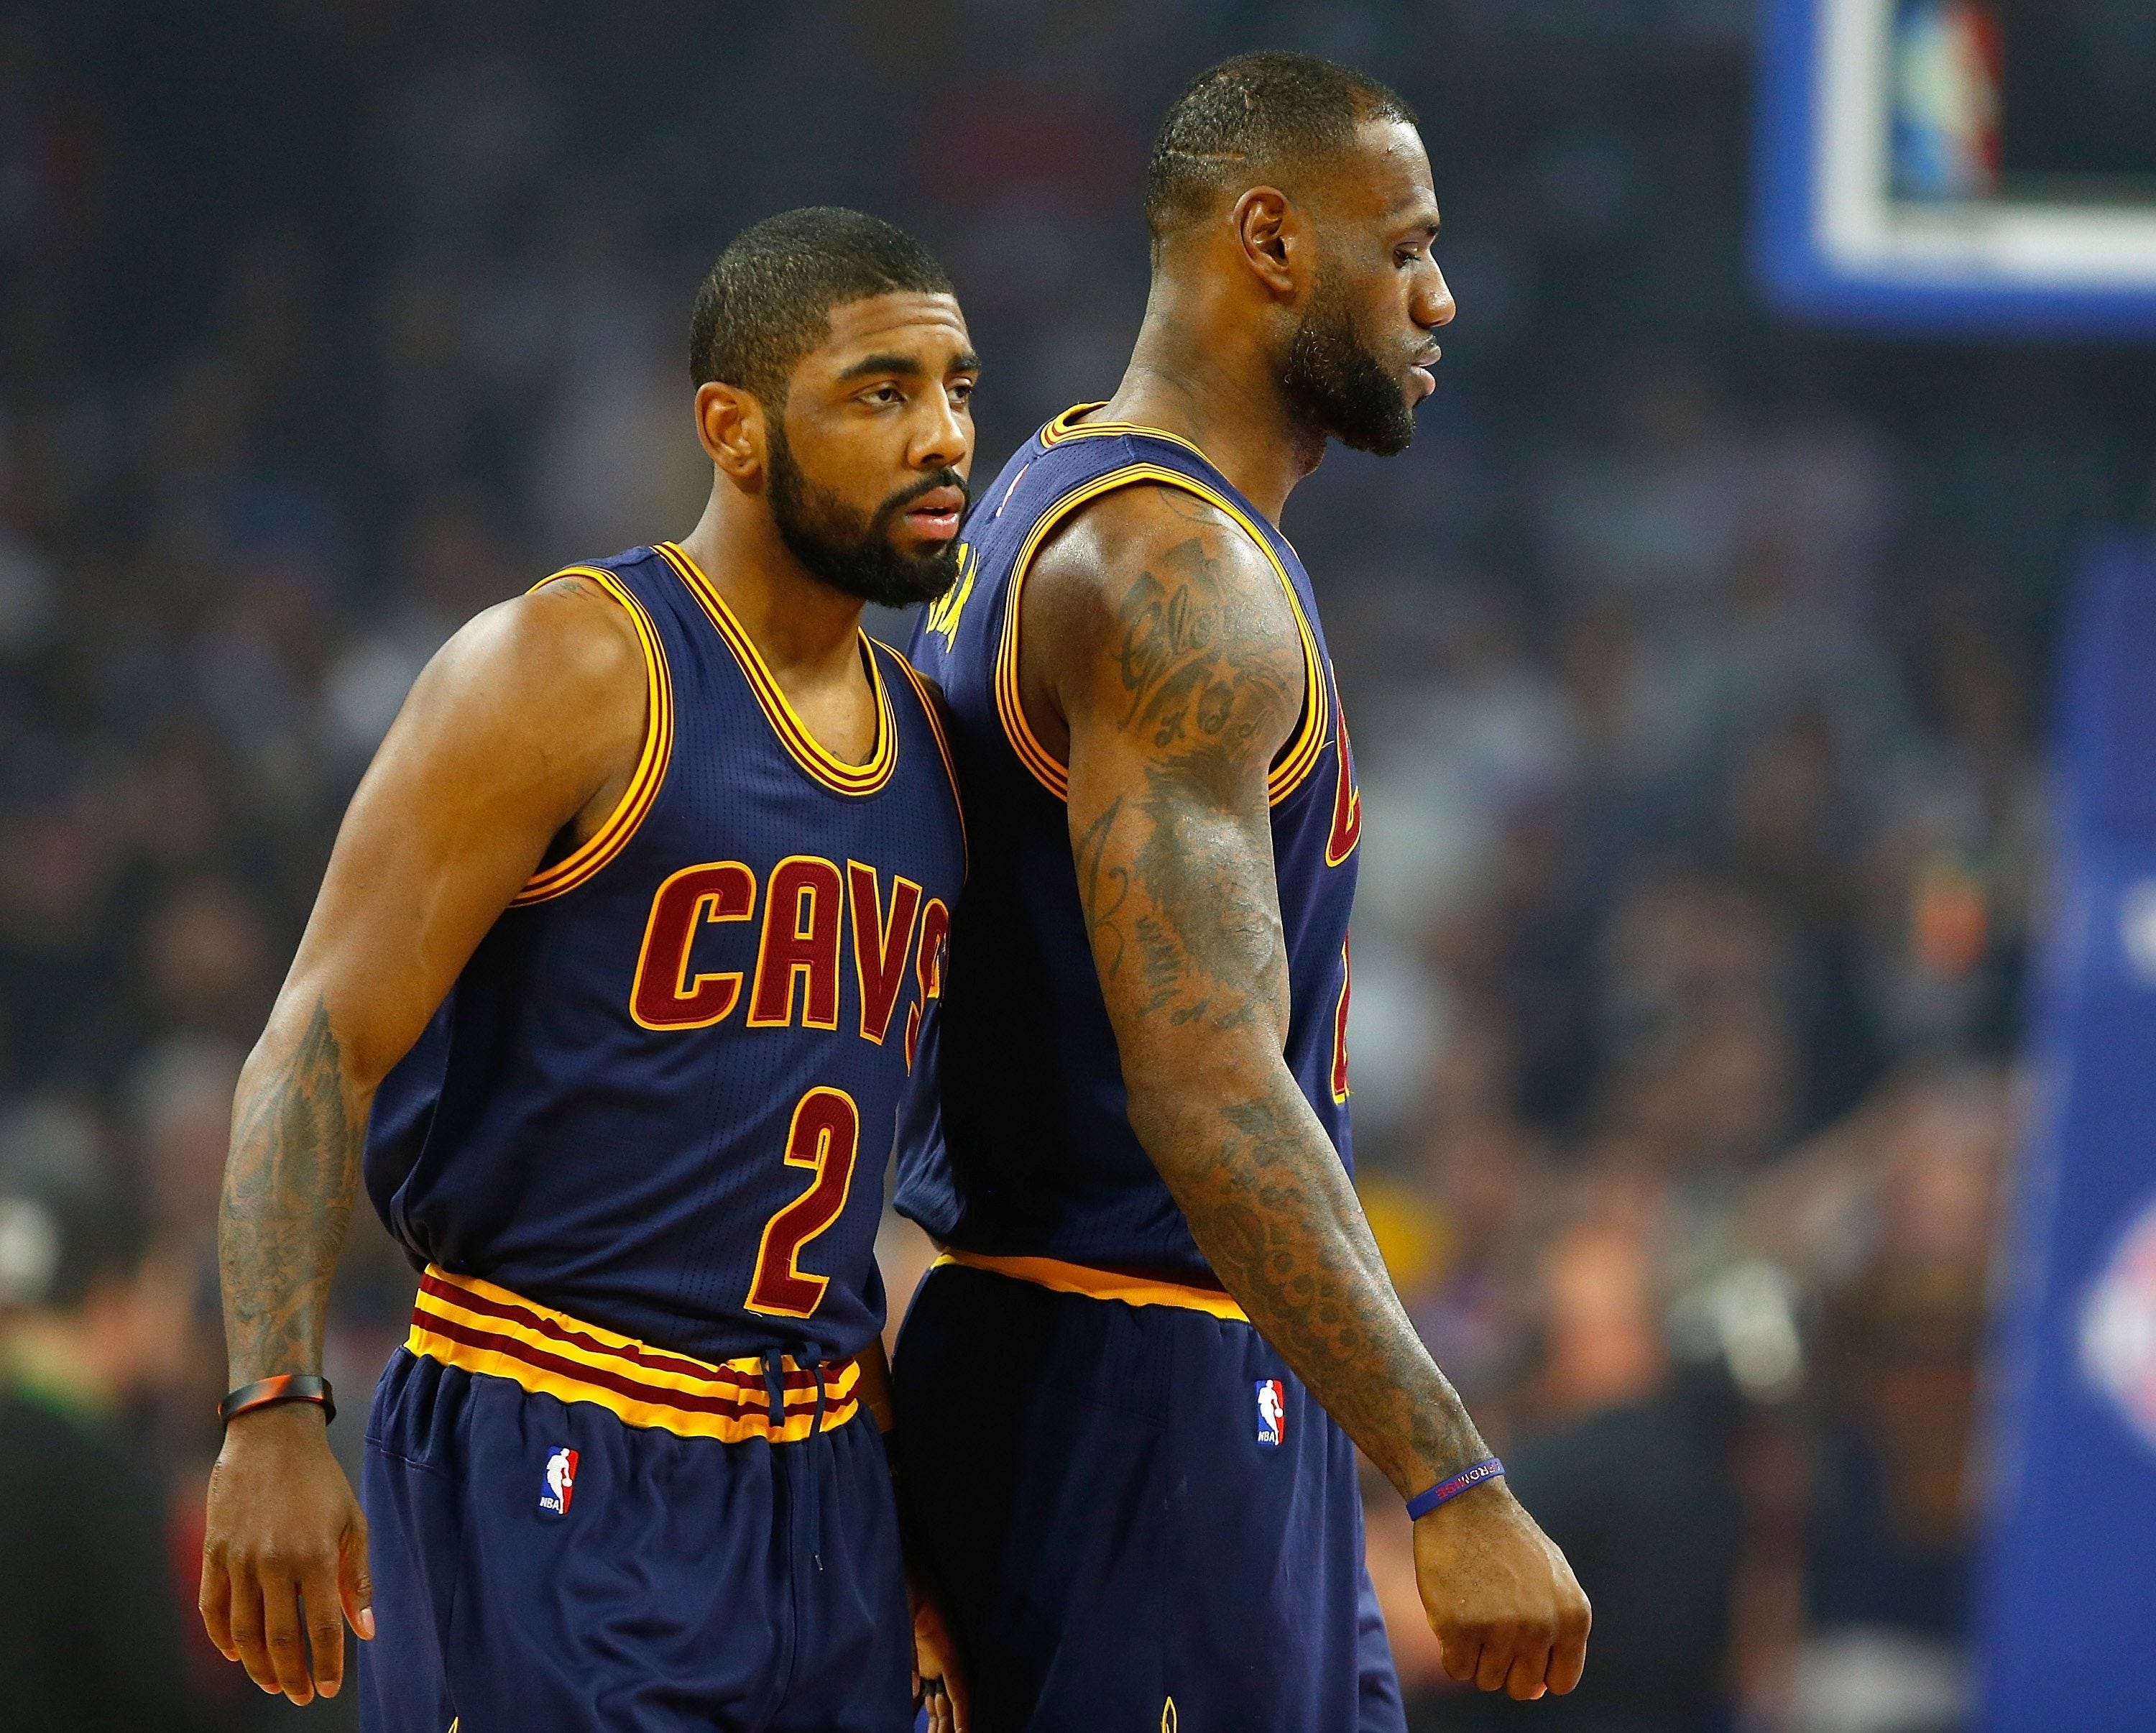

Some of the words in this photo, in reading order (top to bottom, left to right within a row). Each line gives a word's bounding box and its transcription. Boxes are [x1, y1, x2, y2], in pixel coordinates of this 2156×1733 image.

[743, 1086, 860, 1318] 2
[1258, 1431, 1275, 1442] NBA
[540, 1497, 559, 1511] NBA
